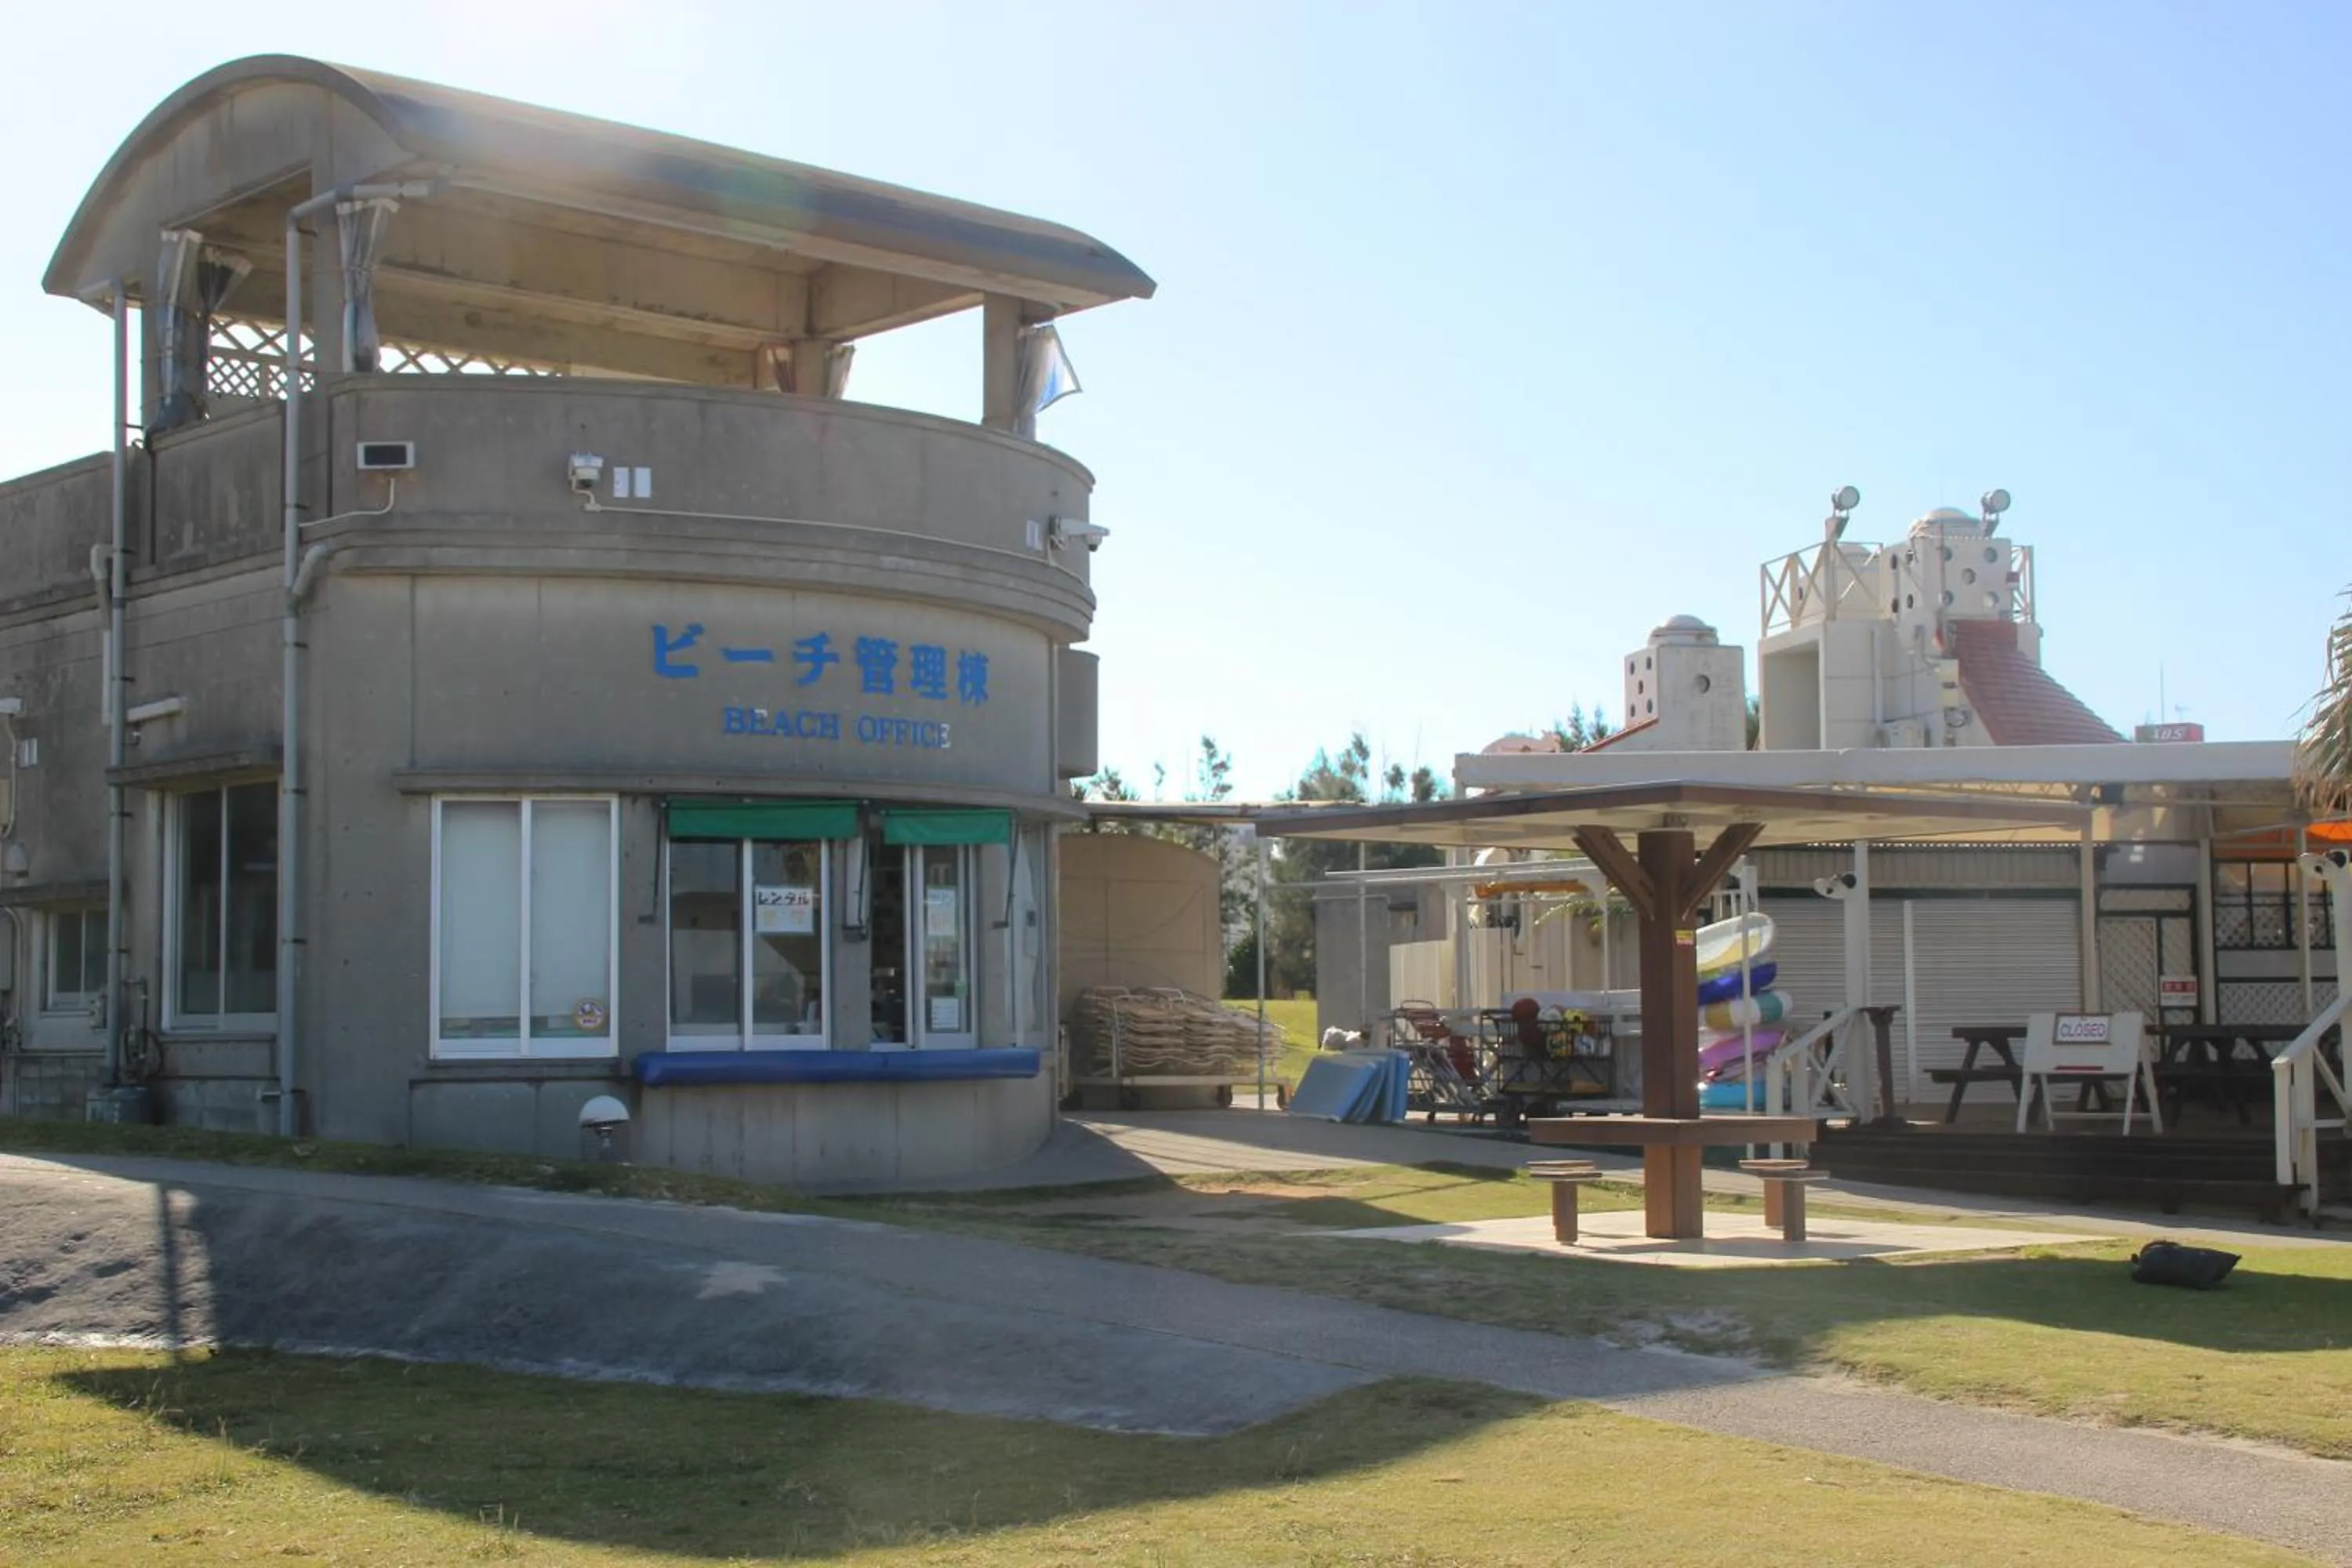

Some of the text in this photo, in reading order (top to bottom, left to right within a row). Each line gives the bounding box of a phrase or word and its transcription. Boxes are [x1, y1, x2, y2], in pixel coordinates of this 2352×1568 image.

[652, 623, 989, 706] ビーチ管理棟
[723, 706, 951, 749] BEACH OFFICE
[758, 891, 810, 906] レンタル
[2060, 1022, 2107, 1037] CLOSED
